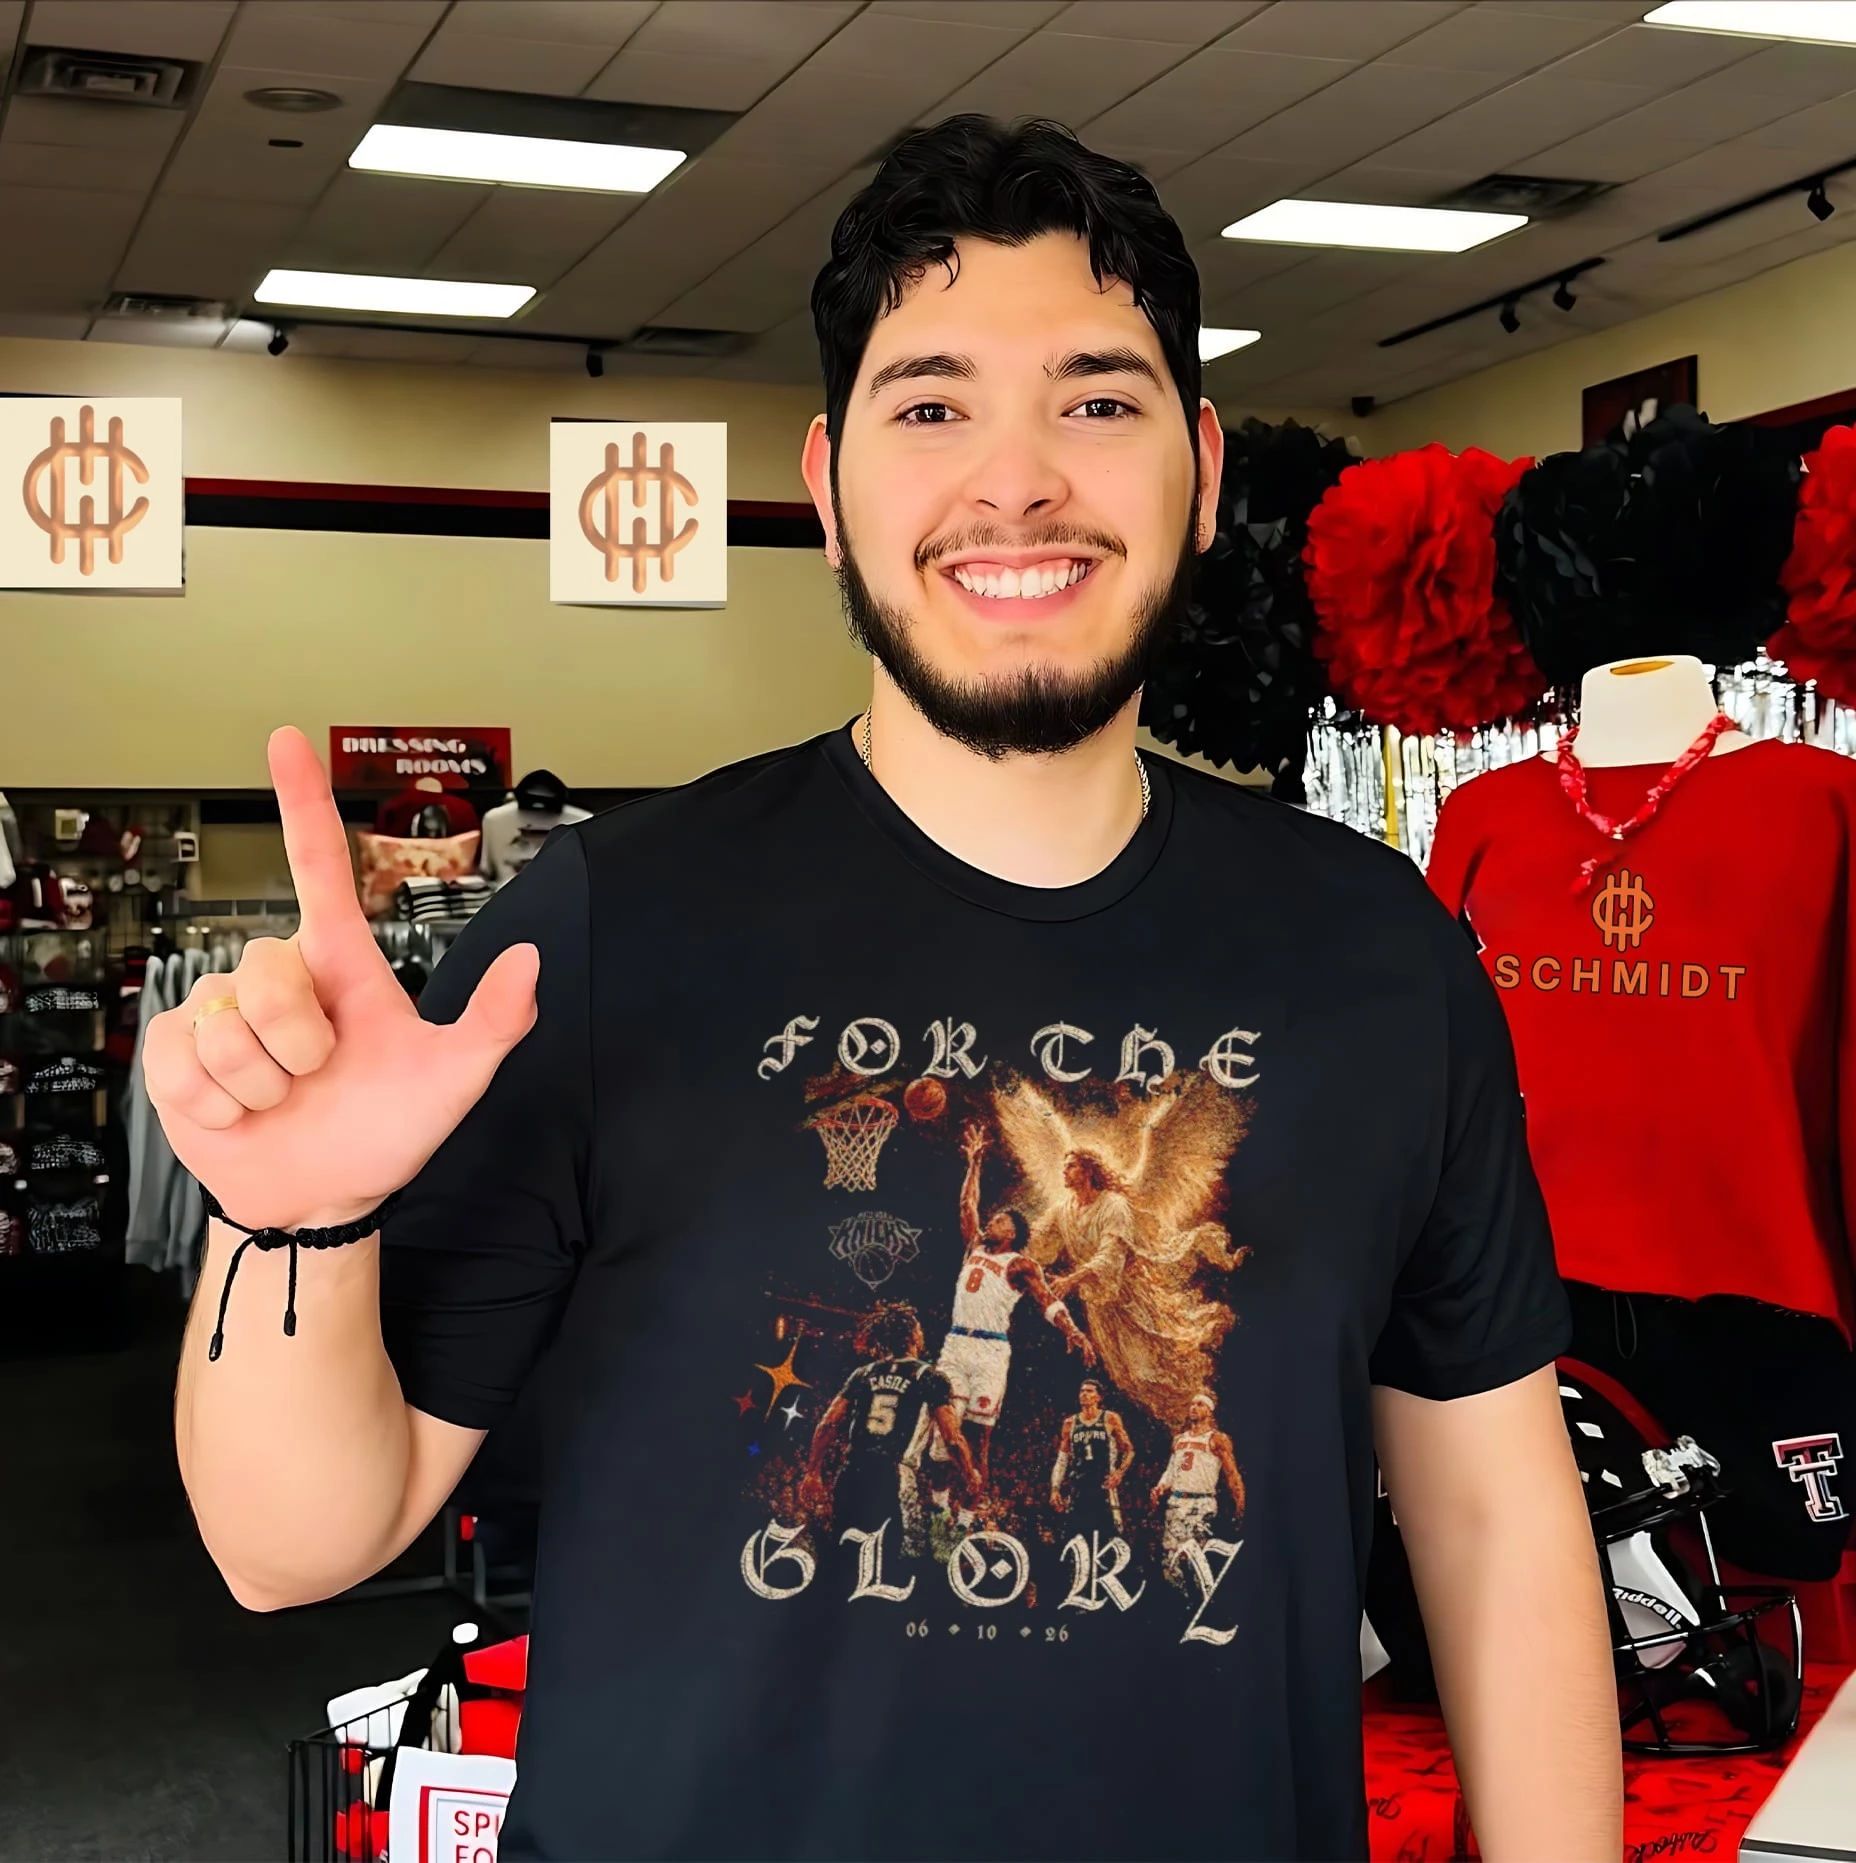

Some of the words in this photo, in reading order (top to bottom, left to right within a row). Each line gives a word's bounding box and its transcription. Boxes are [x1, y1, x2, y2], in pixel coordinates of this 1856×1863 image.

[396, 758, 487, 775] ROOMS
[1494, 954, 1746, 1000] SCHMIDT
[757, 1015, 988, 1081] FOR
[1030, 1020, 1262, 1095] THE
[965, 1268, 985, 1293] 8
[866, 1394, 899, 1435] 5
[1085, 1444, 1094, 1461] 1
[1181, 1452, 1195, 1472] 3
[740, 1516, 1244, 1646] GLORY
[906, 1618, 929, 1638] 06
[977, 1624, 997, 1641] 10
[1045, 1624, 1069, 1643] 26
